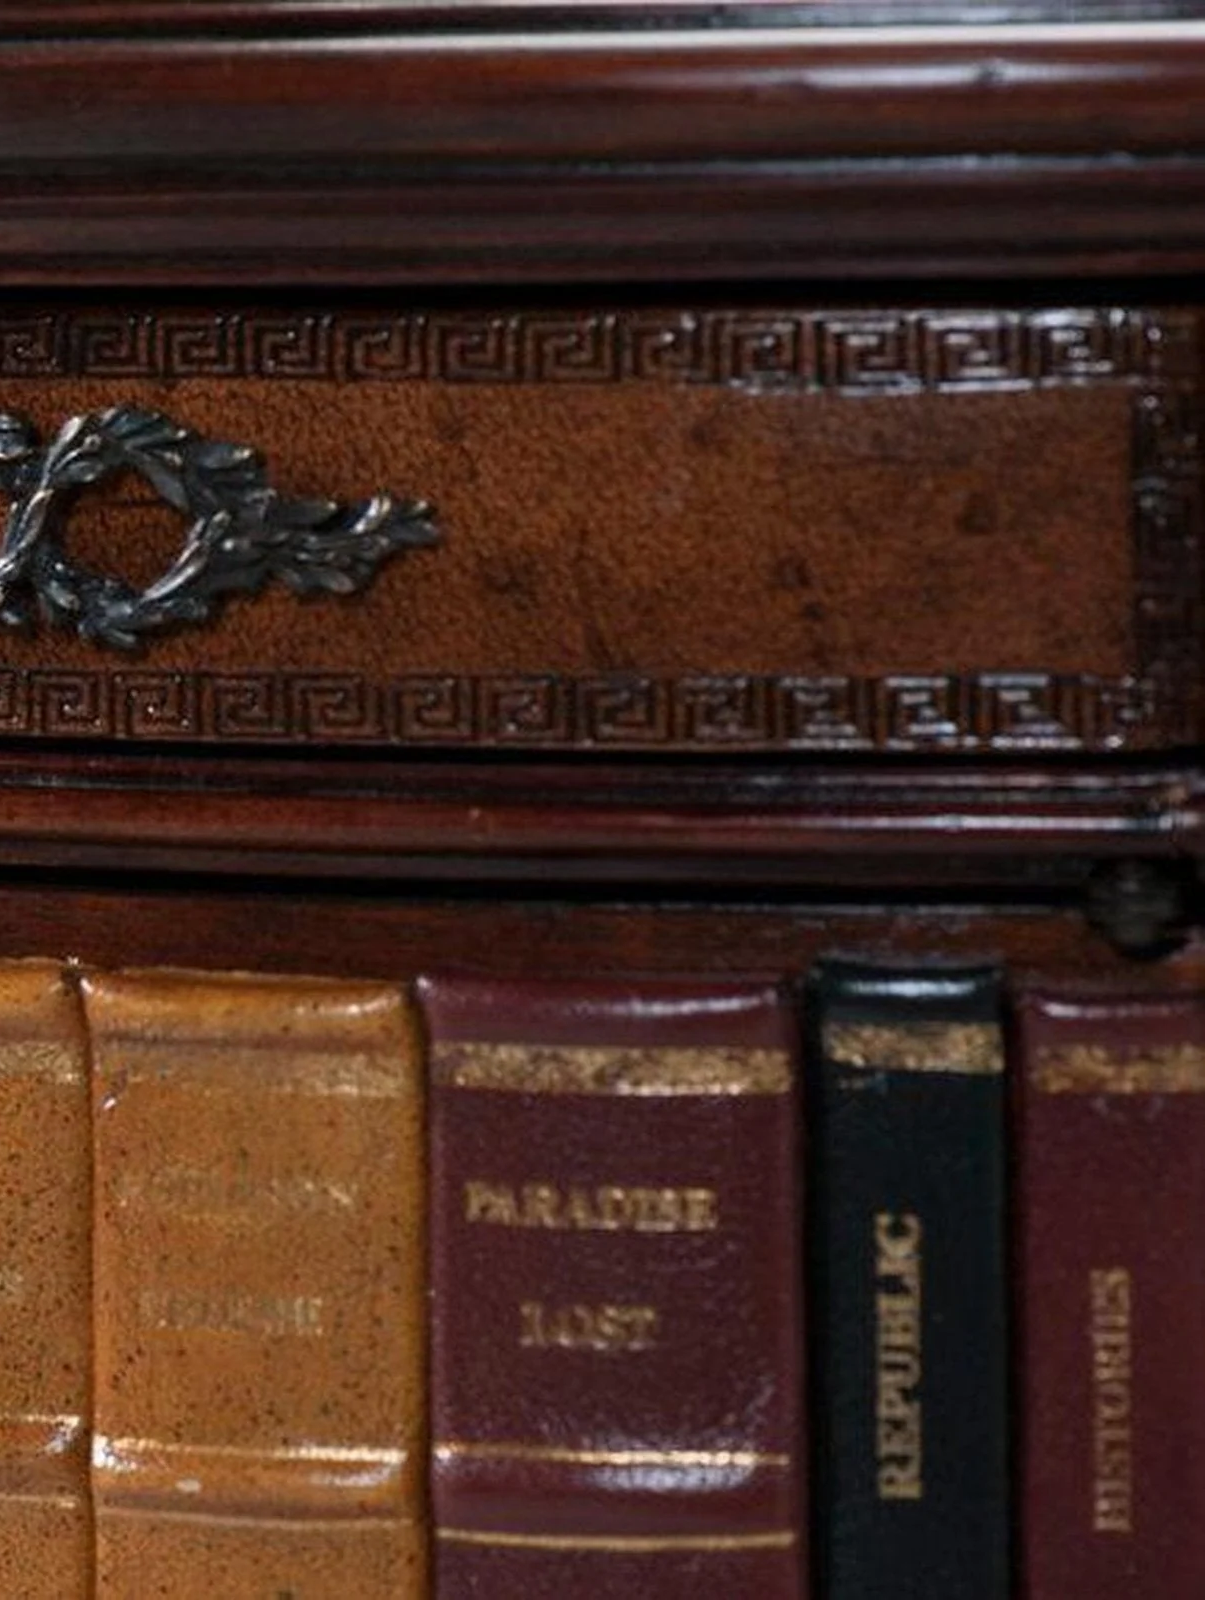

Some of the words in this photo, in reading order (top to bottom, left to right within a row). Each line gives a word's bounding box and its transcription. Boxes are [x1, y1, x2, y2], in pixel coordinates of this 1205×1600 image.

[464, 1181, 719, 1232] PARADISE
[520, 1303, 659, 1350] LOST
[876, 1212, 923, 1500] REPUBLIC
[1092, 1269, 1132, 1532] HISTORIES
